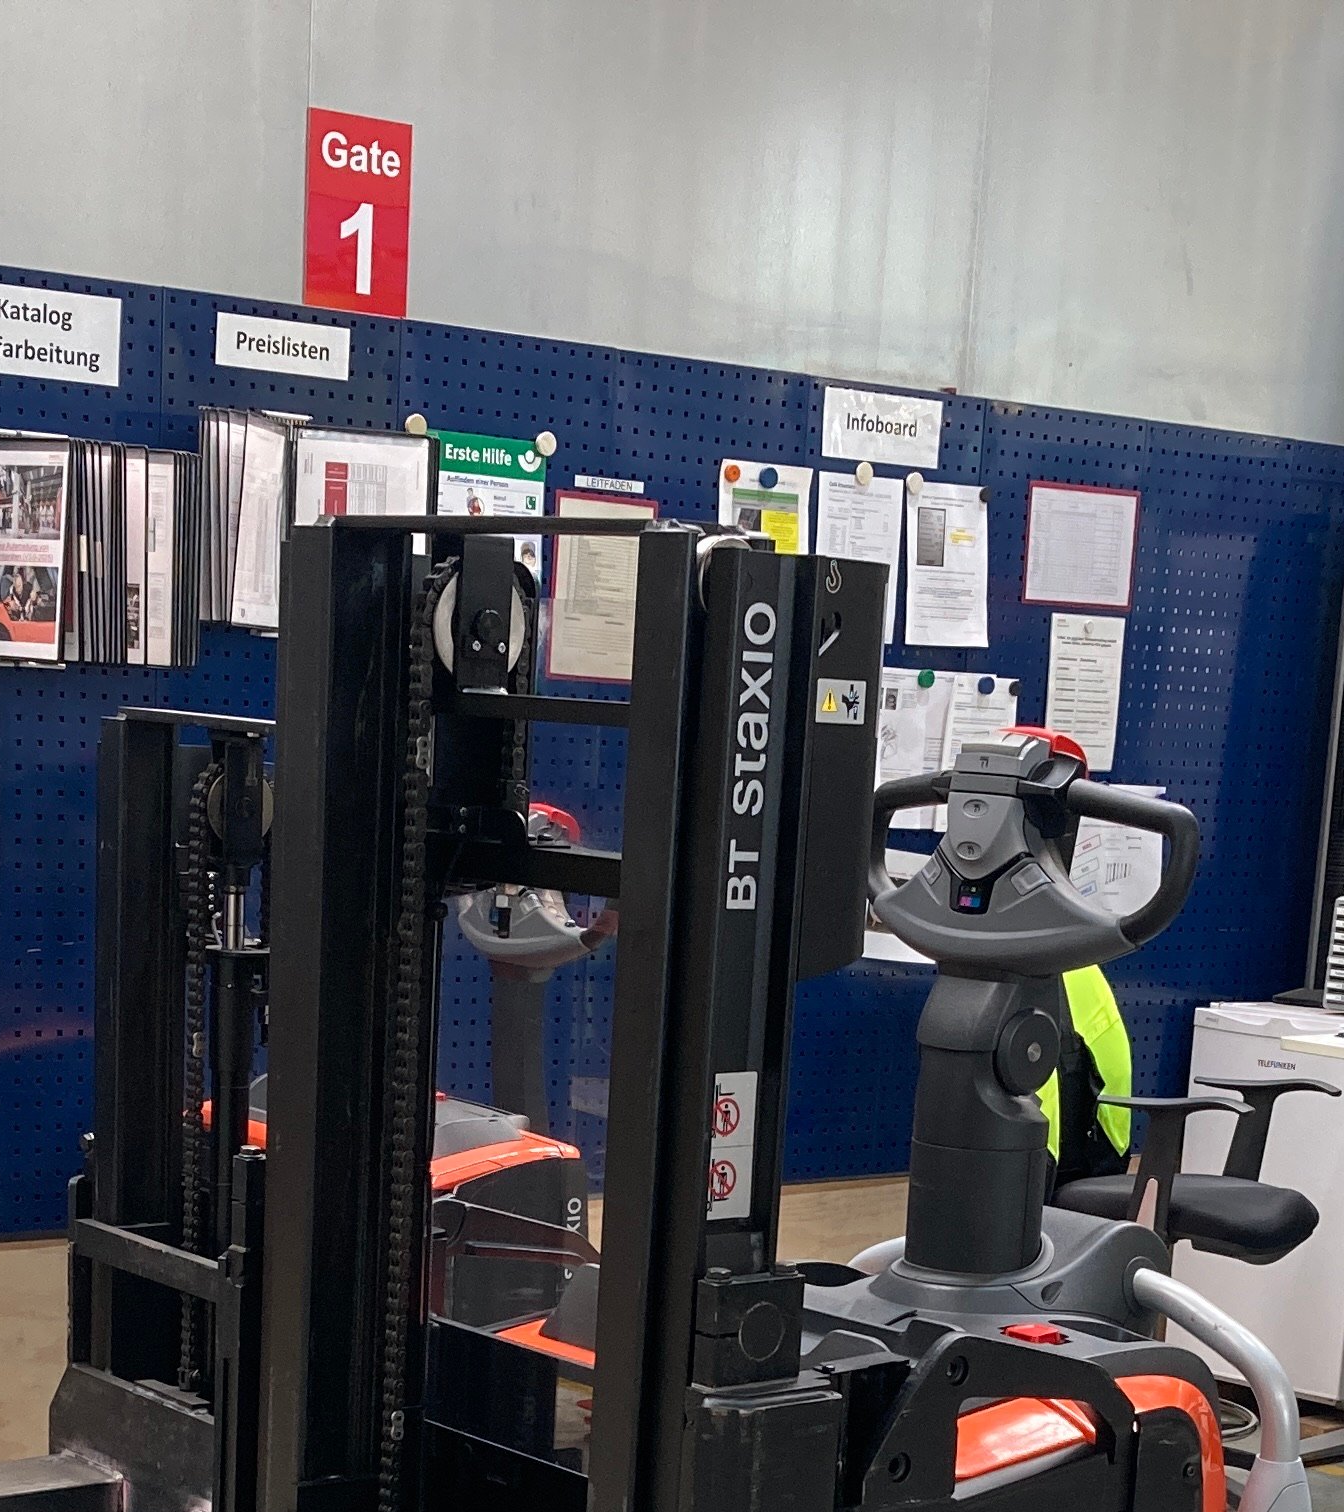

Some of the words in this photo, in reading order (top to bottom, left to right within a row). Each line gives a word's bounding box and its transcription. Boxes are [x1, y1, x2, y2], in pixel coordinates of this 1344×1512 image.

[321, 131, 401, 178] Gate
[340, 202, 374, 296] 1
[235, 331, 331, 362] Preislisten
[846, 412, 918, 438] Infoboard
[445, 444, 479, 462] Erste
[482, 447, 512, 466] Hilfe
[586, 477, 633, 492] LEITFADEN
[726, 838, 760, 910] BT
